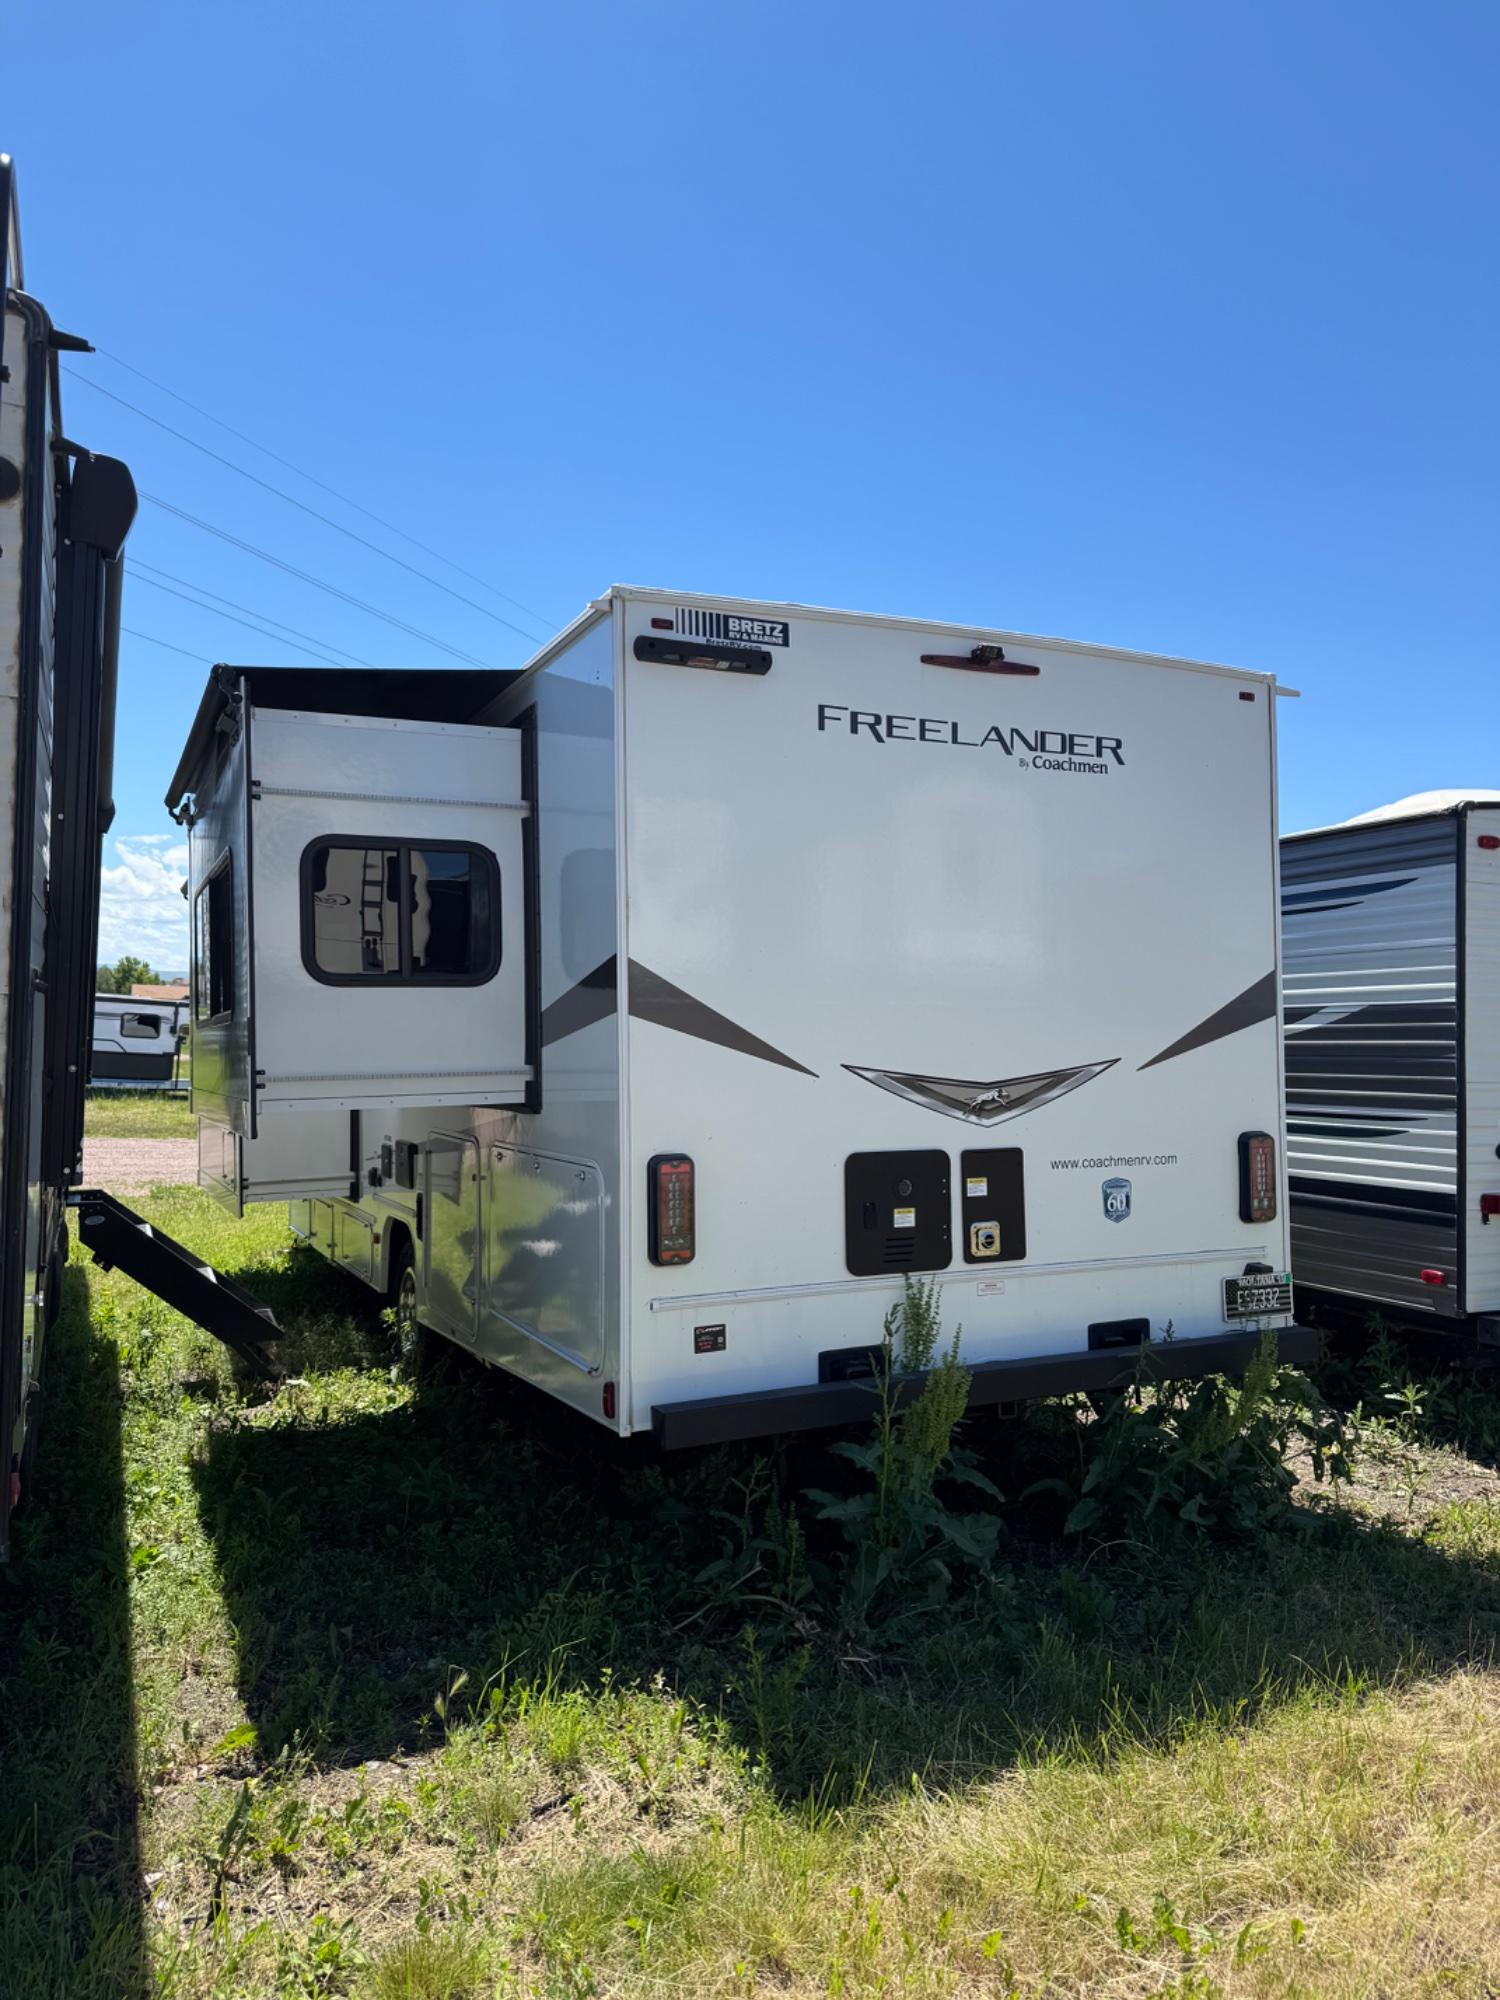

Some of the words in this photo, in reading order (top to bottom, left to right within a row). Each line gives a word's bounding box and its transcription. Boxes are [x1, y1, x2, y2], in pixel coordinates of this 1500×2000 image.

[728, 617, 784, 637] BRETZ
[728, 631, 741, 640] RV
[750, 633, 784, 645] MARINE
[818, 704, 1126, 765] FREELANDER
[1032, 755, 1109, 774] Coachmen
[1049, 1155, 1178, 1170] www.coachmenrv.com
[1107, 1191, 1127, 1212] 60
